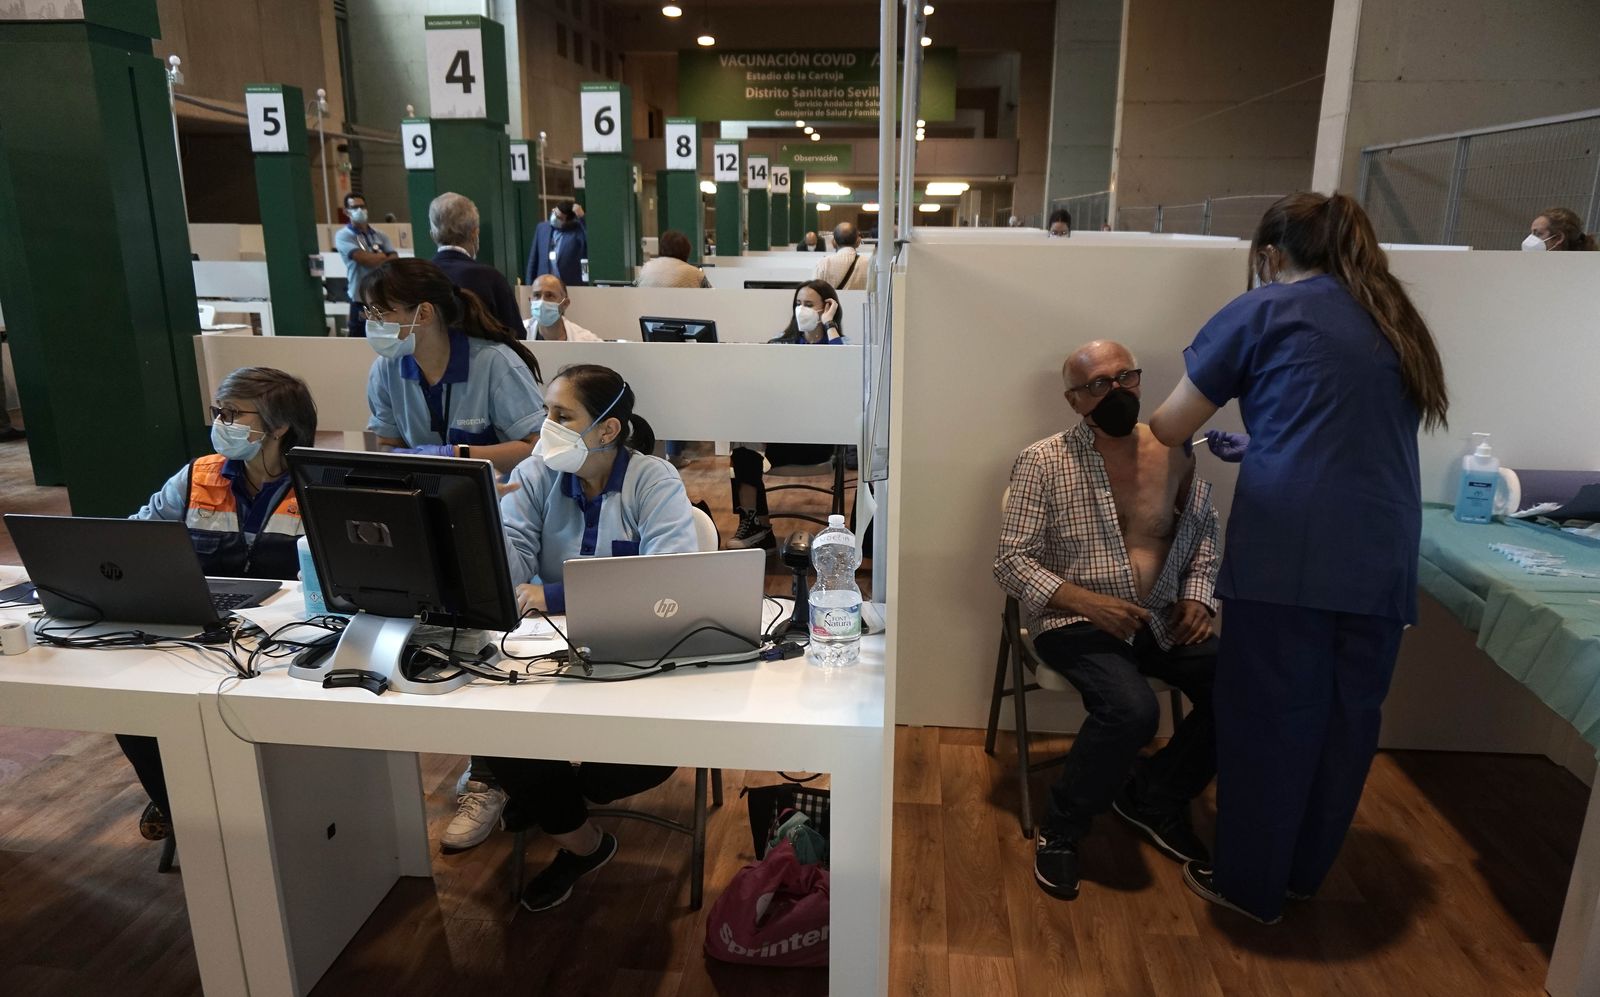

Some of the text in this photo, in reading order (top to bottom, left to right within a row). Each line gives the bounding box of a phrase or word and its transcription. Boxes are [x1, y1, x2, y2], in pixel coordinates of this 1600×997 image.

[720, 52, 856, 67] VACUNACIÓN COVID
[445, 50, 476, 93] 4
[746, 71, 844, 82] Estadio de la Cartuja
[745, 86, 880, 98] Distrito Sanitario Sevill
[815, 109, 824, 117] de
[826, 109, 847, 117] Salud
[854, 109, 880, 117] Familia
[263, 107, 281, 136] 5
[594, 106, 615, 136] 6
[412, 134, 427, 156] 9
[676, 135, 692, 157] 8
[510, 153, 527, 171] 11
[716, 153, 738, 171] 12
[793, 154, 838, 162] Observación
[575, 165, 585, 180] 1
[749, 165, 768, 180] 14
[773, 173, 789, 186] 16
[655, 599, 678, 618] hp
[824, 619, 852, 627] Natura
